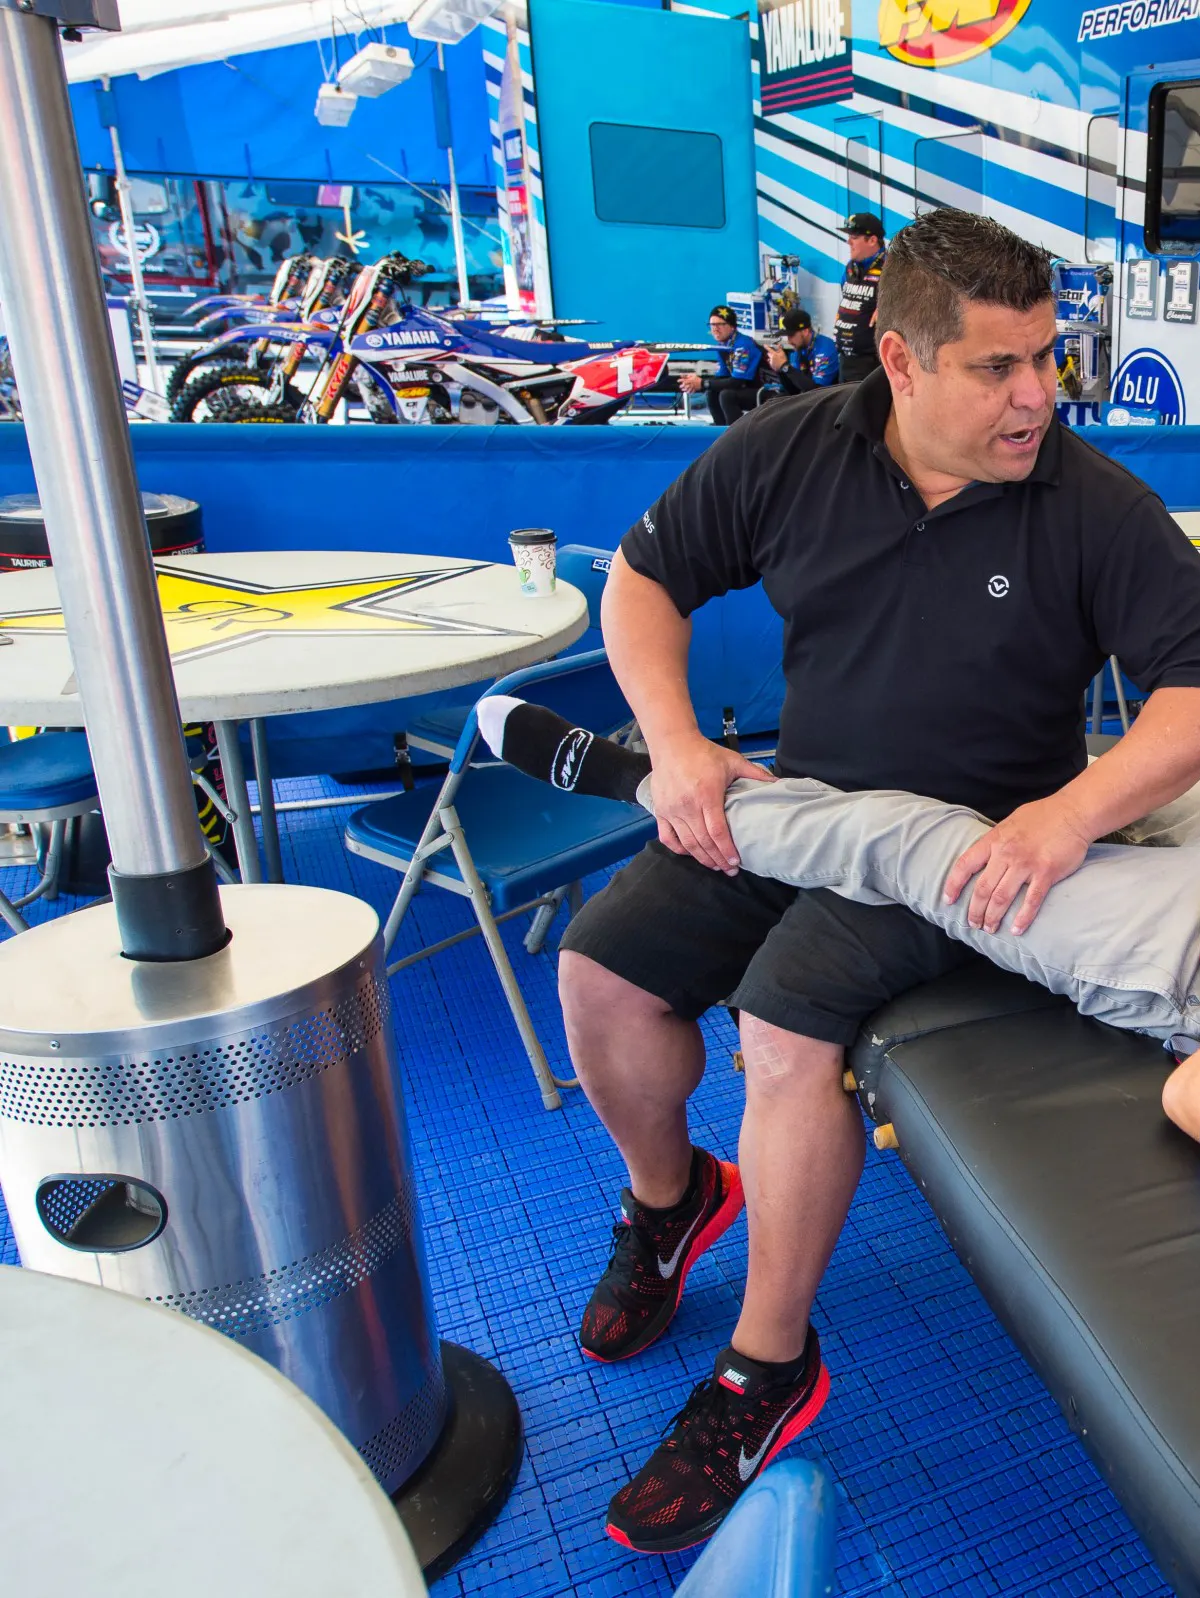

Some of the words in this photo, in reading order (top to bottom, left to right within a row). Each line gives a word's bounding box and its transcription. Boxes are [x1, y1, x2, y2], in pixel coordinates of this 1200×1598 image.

[762, 0, 847, 74] YAMALUBE
[381, 329, 440, 347] YAMAHA
[654, 342, 711, 350] DUNLOP
[609, 356, 635, 394] 1
[10, 556, 48, 569] TAURINE
[723, 1368, 748, 1386] NIKE
